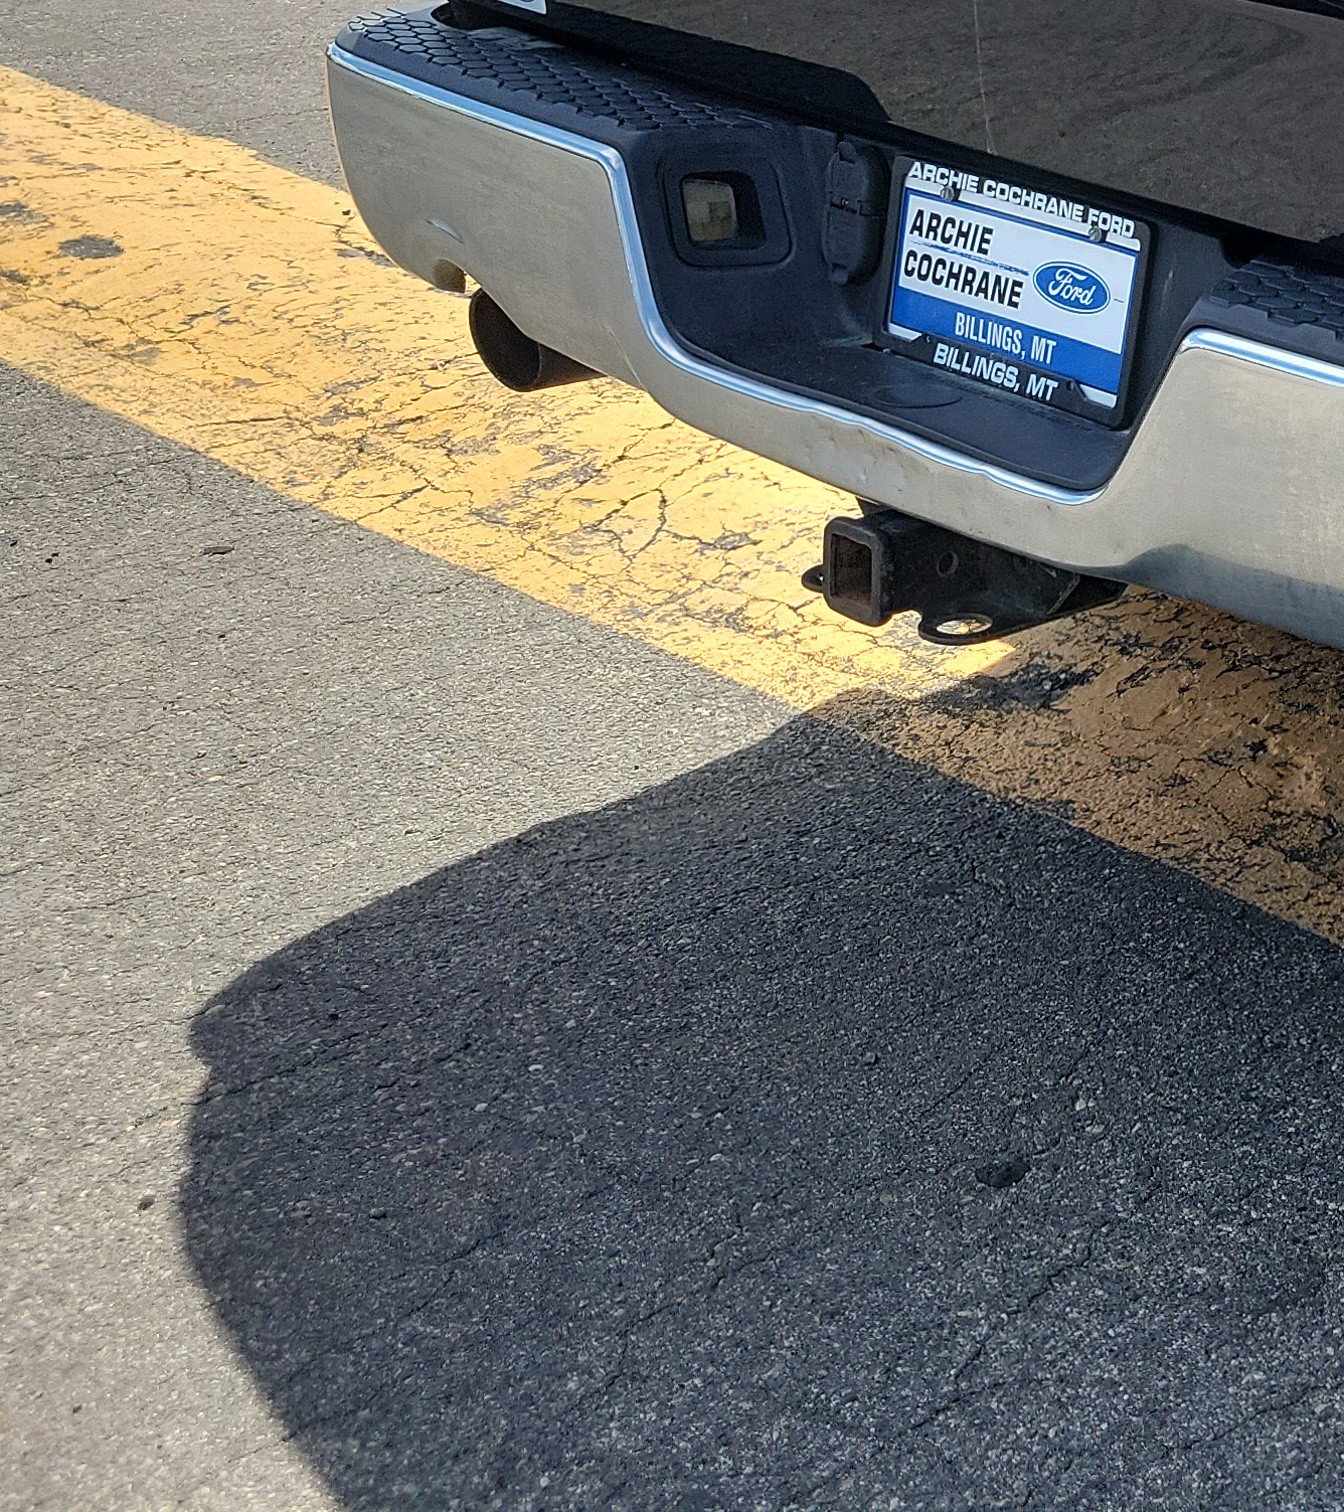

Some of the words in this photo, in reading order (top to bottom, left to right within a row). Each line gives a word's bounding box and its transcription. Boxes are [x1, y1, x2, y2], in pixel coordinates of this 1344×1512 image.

[909, 161, 979, 193] ARCHIE
[982, 179, 1084, 222] COCHRANE
[1088, 208, 1136, 239] FORD
[909, 208, 994, 256] ARCHIE
[903, 250, 1024, 310] COCHRANE
[955, 312, 1027, 360] BILLINGS,
[1030, 335, 1057, 365] MT
[933, 344, 1020, 394] BILLINGS,
[1026, 373, 1059, 402] MT
